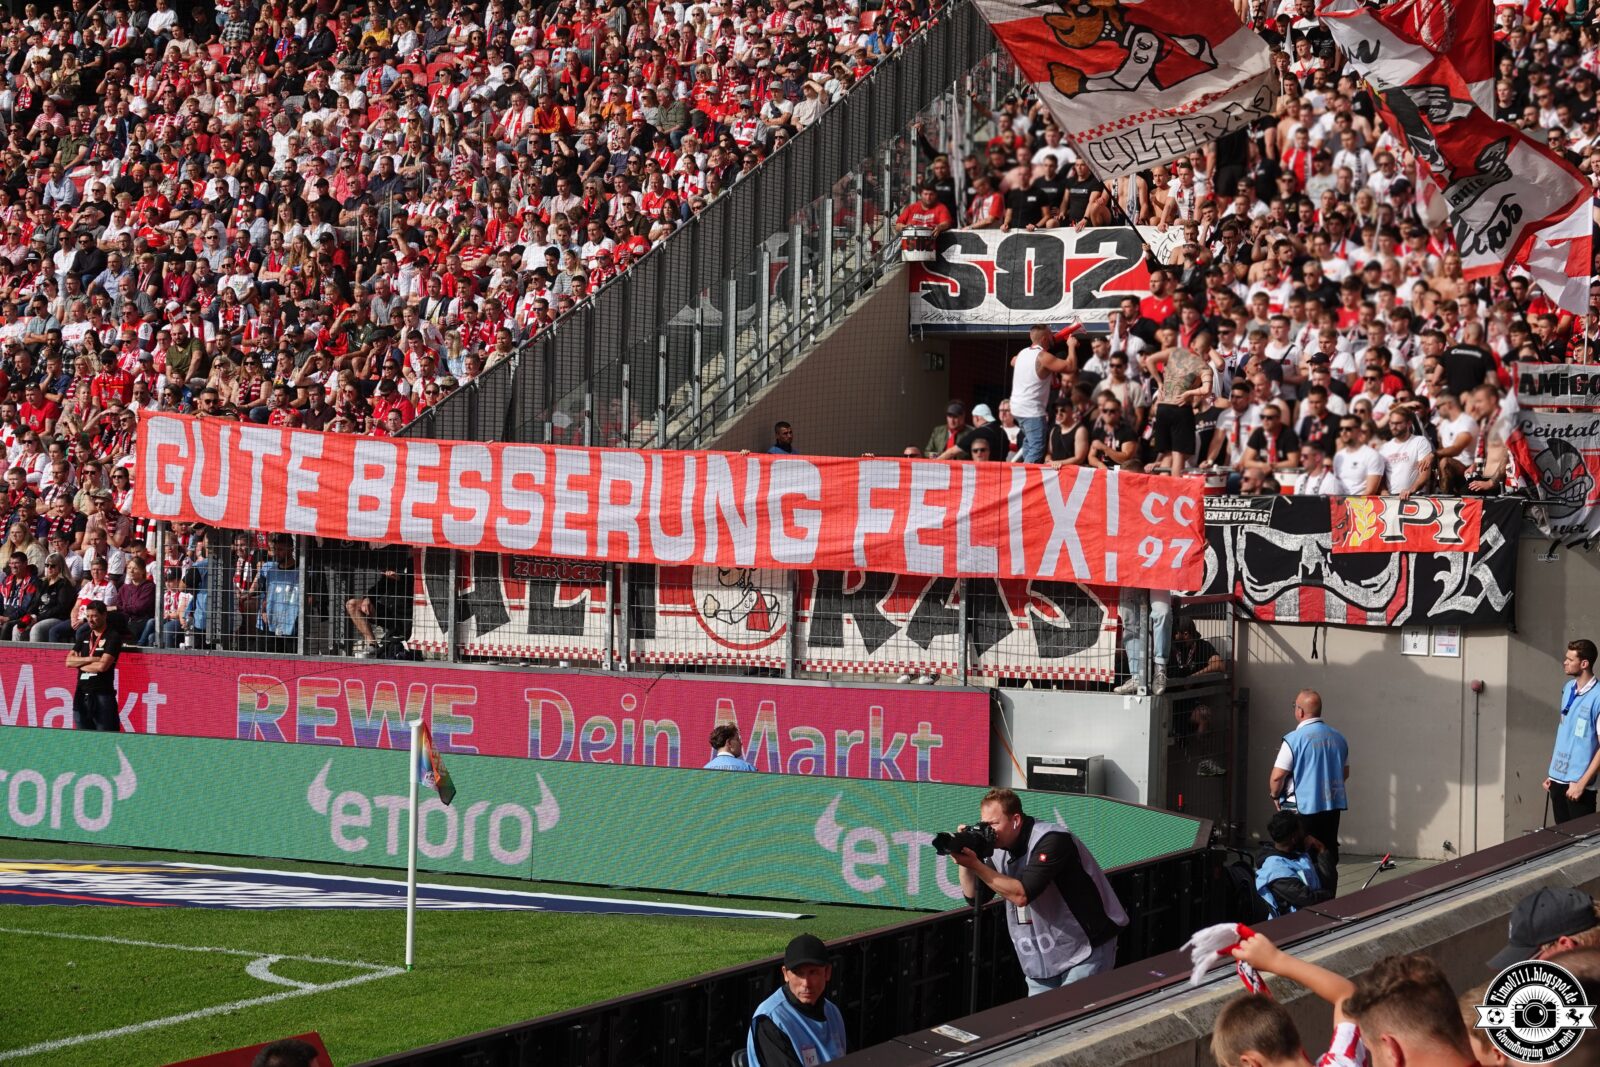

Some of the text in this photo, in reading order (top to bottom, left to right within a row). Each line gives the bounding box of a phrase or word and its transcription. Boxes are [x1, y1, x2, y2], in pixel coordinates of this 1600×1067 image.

[146, 416, 325, 534] GUTE
[346, 440, 822, 567] BESSERUNG
[852, 459, 1120, 583] FELIX!
[1140, 491, 1197, 527] CC
[1204, 510, 1270, 523] ENEN ULTRAS
[1379, 496, 1466, 544] PI
[1137, 535, 1194, 569] 97
[0, 664, 167, 734] Makt
[237, 673, 479, 755] REWE
[524, 686, 681, 767] Dein
[0, 768, 114, 832] oro
